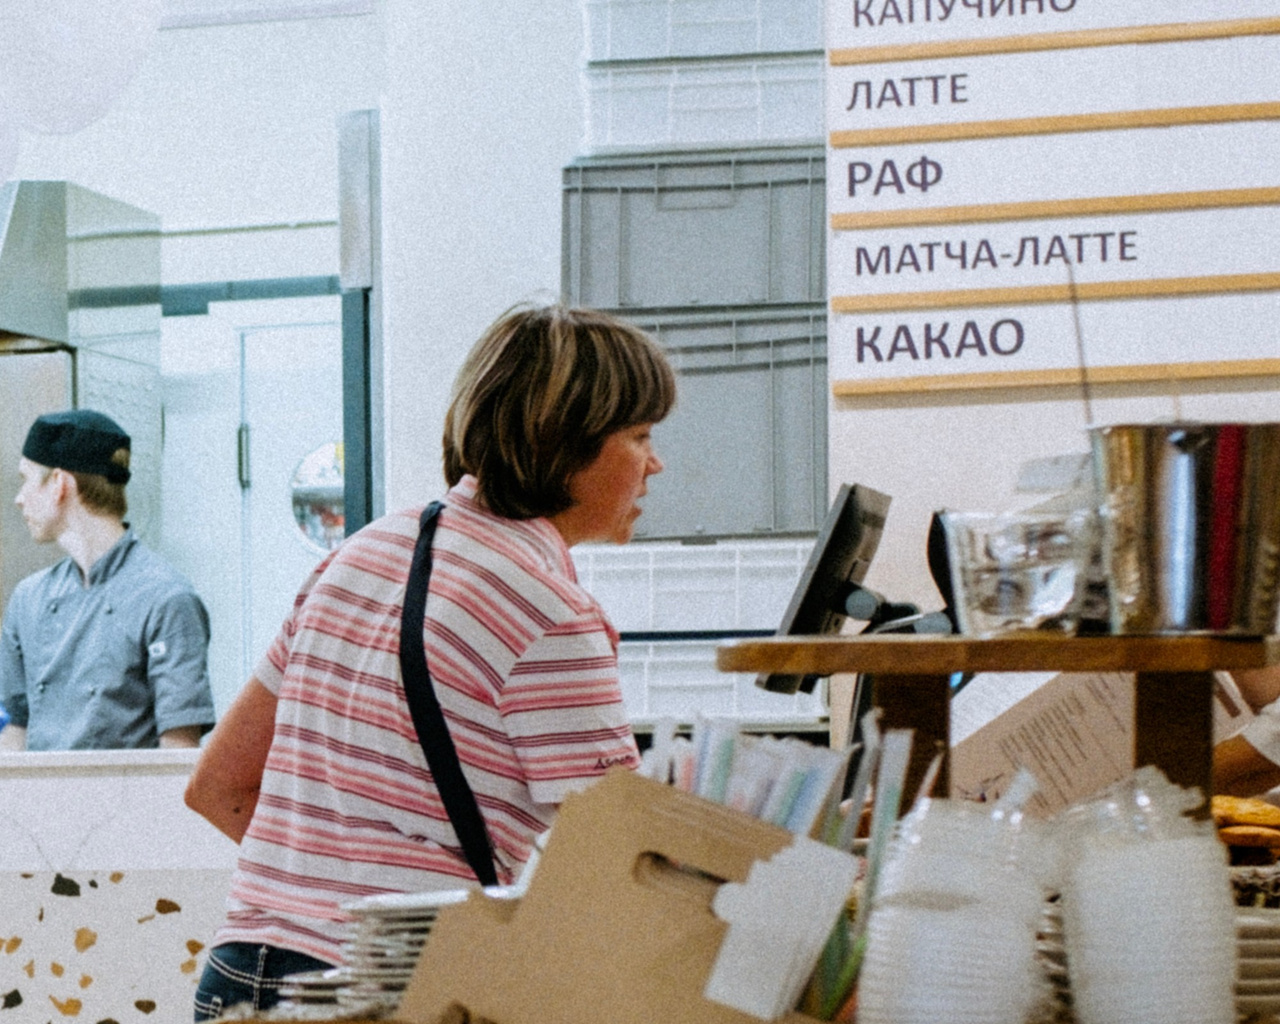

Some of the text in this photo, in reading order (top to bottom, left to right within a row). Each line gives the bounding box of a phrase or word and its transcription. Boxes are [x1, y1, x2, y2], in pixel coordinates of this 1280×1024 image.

[846, 73, 969, 111] ЛАТТЕ
[847, 155, 944, 198] РАФ
[855, 230, 1138, 276] МАТЧА-ЛАТТЕ
[856, 318, 1026, 364] КАКАО
